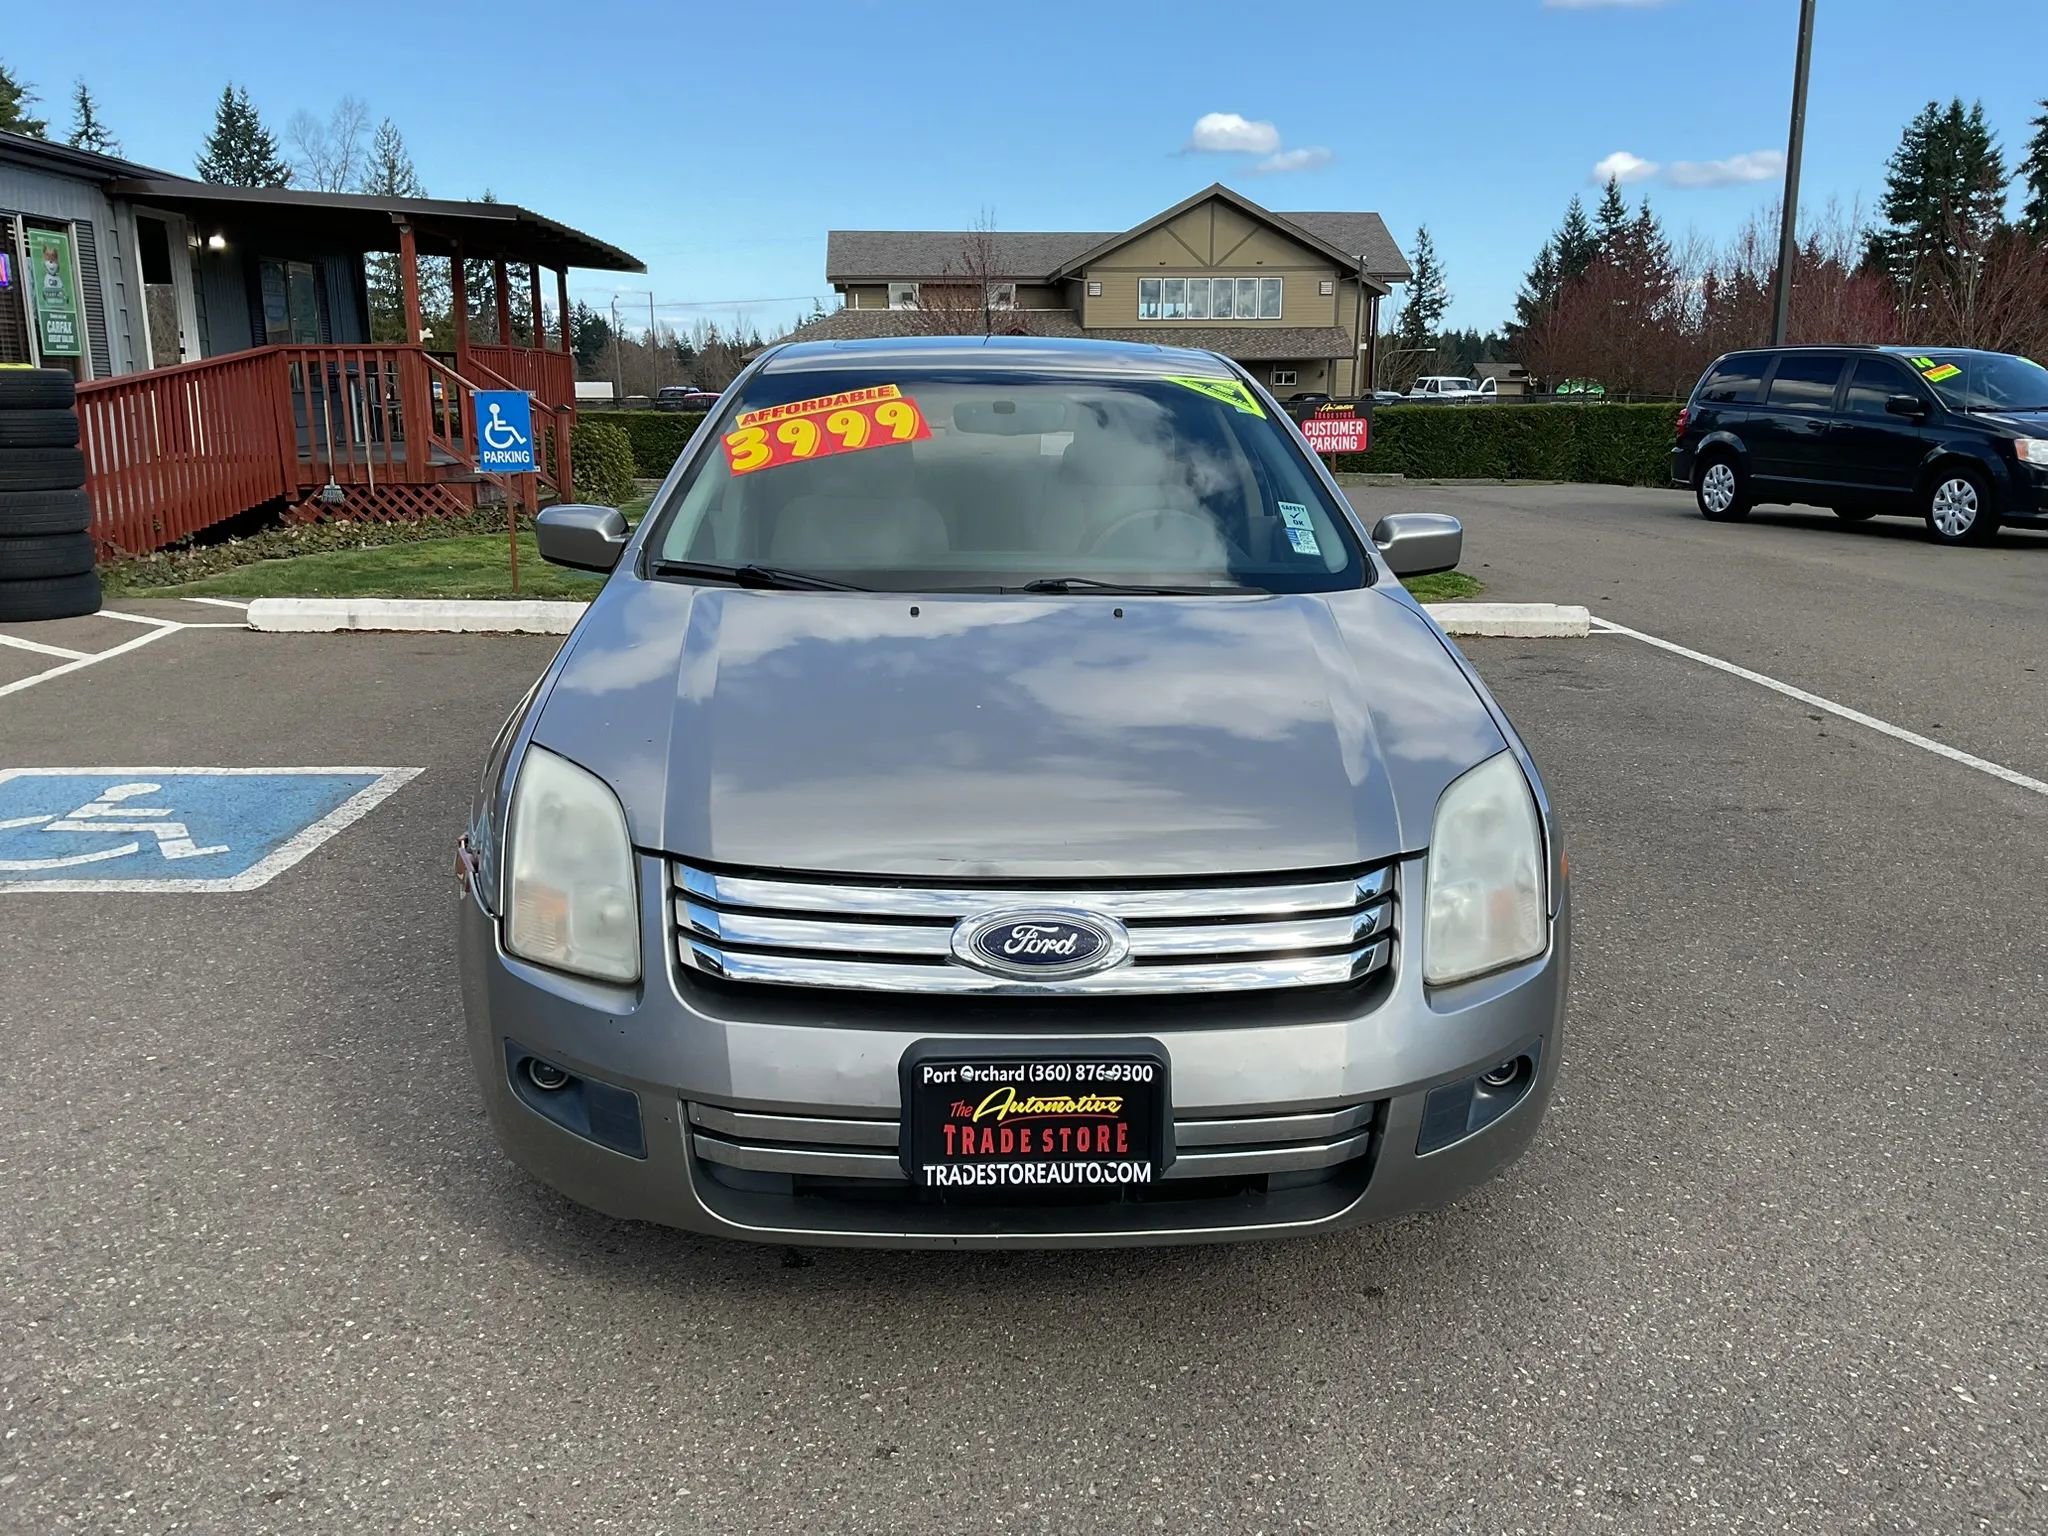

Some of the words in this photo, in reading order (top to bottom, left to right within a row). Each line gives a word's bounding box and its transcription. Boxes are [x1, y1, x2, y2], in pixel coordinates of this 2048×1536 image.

[46, 320, 72, 334] CARFAX
[741, 386, 892, 426] AFFORDABLE
[726, 401, 919, 472] 3999
[1304, 421, 1364, 436] CUSTOMER
[1310, 436, 1358, 451] PARKING
[484, 450, 530, 463] PARKING
[1281, 504, 1305, 512] SAFETY
[1004, 925, 1077, 954] Ford
[923, 1066, 957, 1084] Port
[960, 1065, 1025, 1082] Orchard
[1029, 1063, 1072, 1082] (360)
[1075, 1064, 1153, 1082] 8769300
[950, 1100, 973, 1118] The
[972, 1086, 1124, 1123] Automotive
[943, 1124, 1033, 1155] TRADE
[1042, 1122, 1128, 1153] STORE
[923, 1162, 1151, 1186] TRADESTOREAUTO.COM
